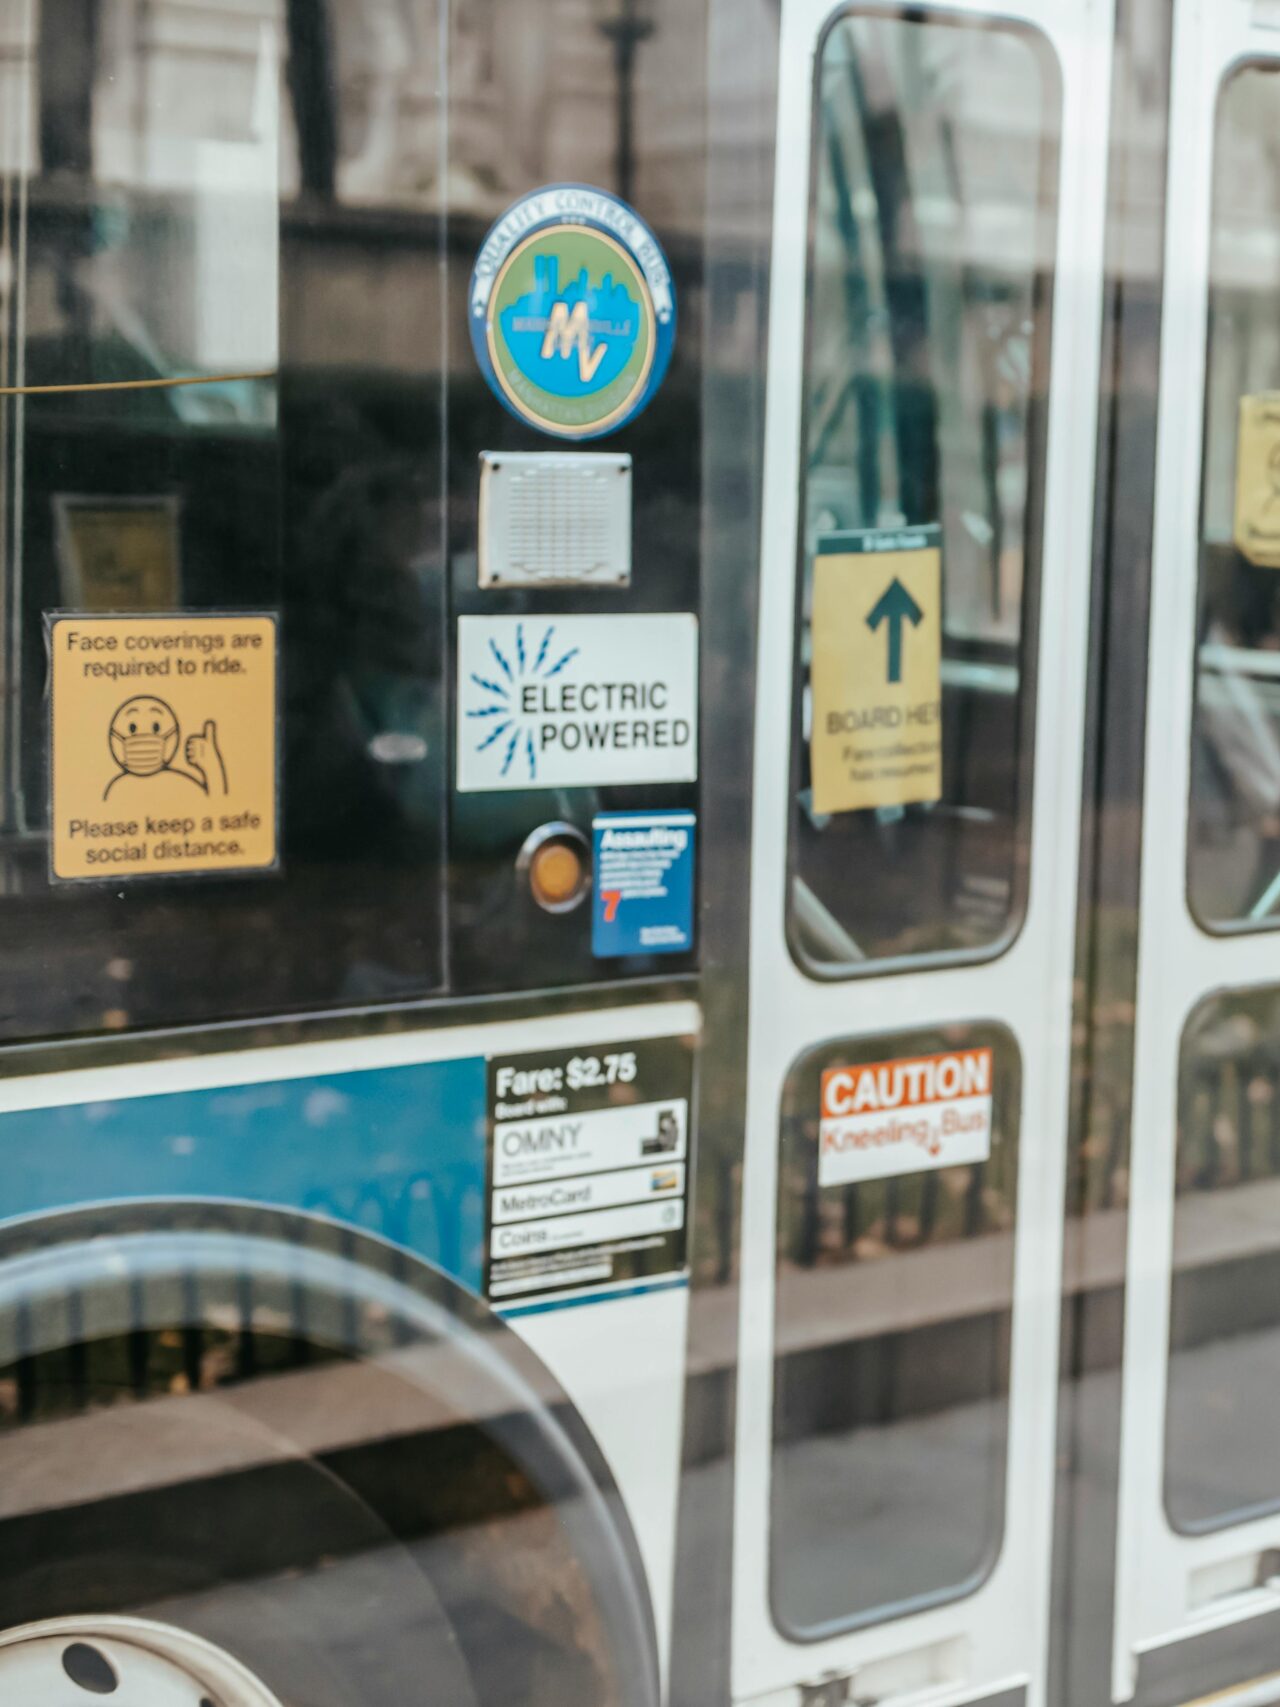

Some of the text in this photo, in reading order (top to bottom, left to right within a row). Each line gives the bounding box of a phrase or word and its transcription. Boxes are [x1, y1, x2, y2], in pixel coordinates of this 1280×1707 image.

[67, 629, 263, 654] Face coverings are
[84, 656, 246, 681] required to ride.
[521, 681, 668, 714] ELECTRIC
[541, 718, 690, 752] POWERED
[826, 704, 902, 736] BOARD
[68, 810, 262, 839] Please keep a safe
[86, 838, 244, 865] social distance.
[601, 889, 622, 922] 7
[496, 1052, 638, 1098] Fare: $2.75
[825, 1053, 990, 1116] CAUTION
[503, 1122, 583, 1158] OMNY
[822, 1107, 986, 1157] Kneeling Bus
[500, 1185, 592, 1214] MetroCard
[499, 1229, 548, 1249] Coins
